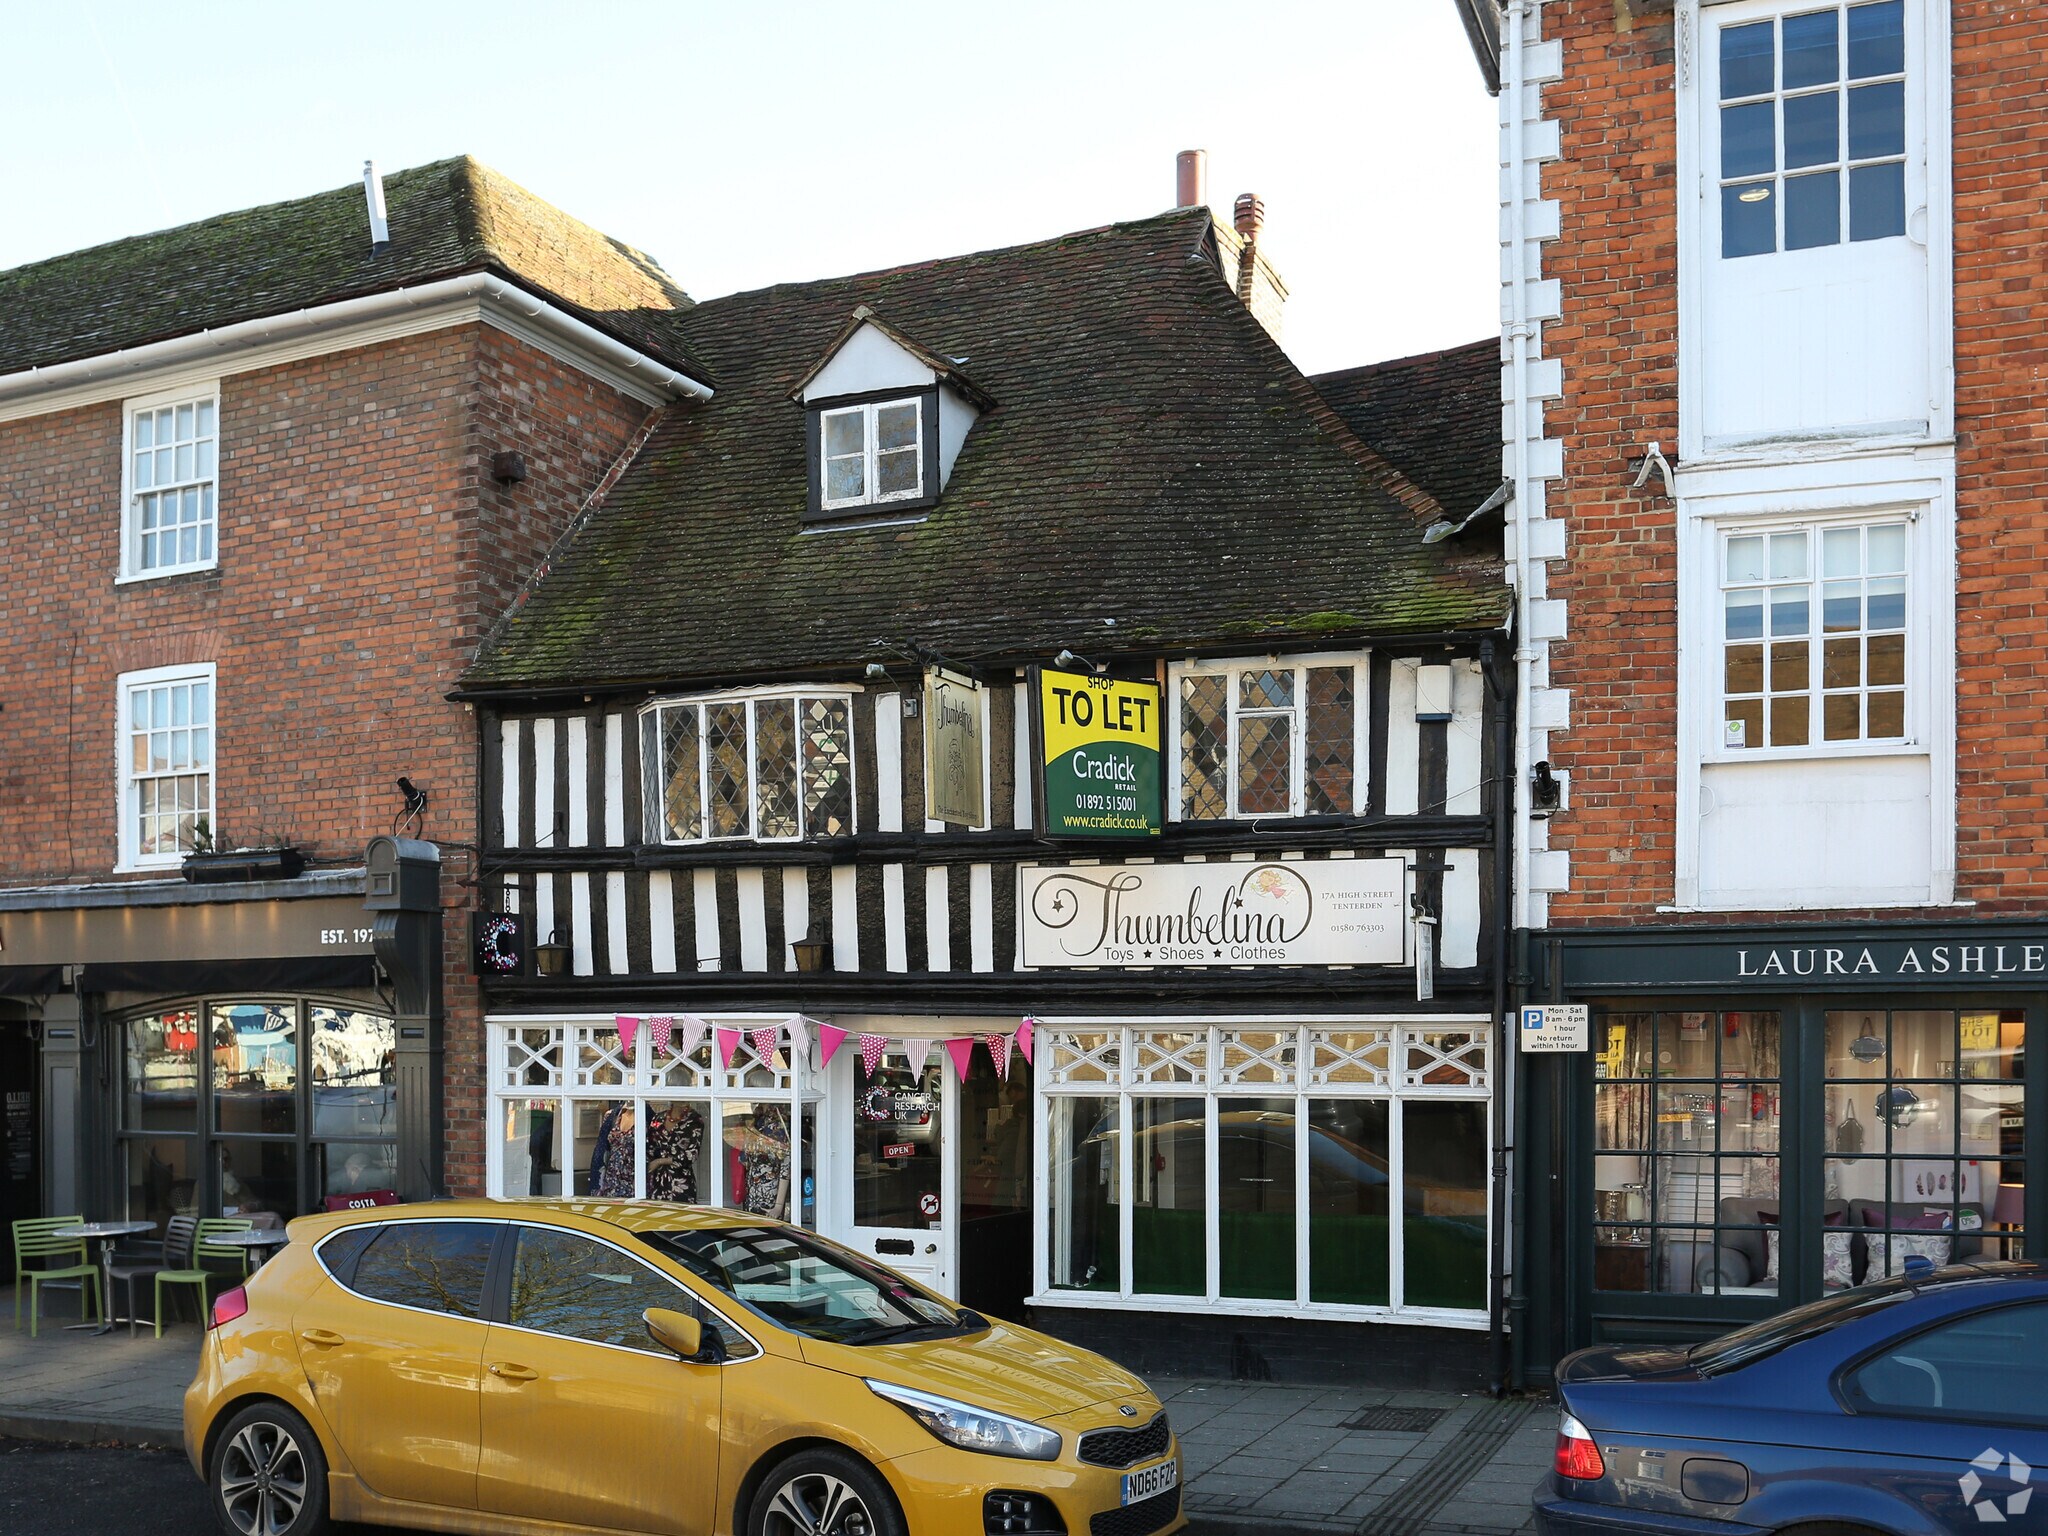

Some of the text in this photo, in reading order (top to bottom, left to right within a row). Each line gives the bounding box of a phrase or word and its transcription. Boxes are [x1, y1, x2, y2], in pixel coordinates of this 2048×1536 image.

[1087, 677, 1114, 691] SHOP
[1052, 687, 1150, 732] TO LET
[1072, 750, 1136, 782] Cradick
[1114, 783, 1137, 792] RETAIL
[1076, 793, 1136, 811] 01892 515001
[1063, 812, 1148, 830] www.cradick.co.uk
[1321, 892, 1335, 900] 17A
[1338, 891, 1360, 899] HIGH
[1032, 864, 1313, 957] Thumbelina
[1332, 902, 1383, 910] TENTERDEN
[1330, 923, 1385, 933] 01580 763303
[321, 929, 348, 944] EST.
[1104, 945, 1286, 960] Toys Shoes Clothes
[1737, 945, 2047, 976] LAURA ASHLE
[894, 1092, 932, 1101] CANCER
[894, 1102, 940, 1111] RESEARCH
[894, 1111, 907, 1120] UK
[888, 1146, 909, 1156] OPEN
[348, 1198, 376, 1209] COSTA
[1129, 1461, 1175, 1498] ND66 FZP
